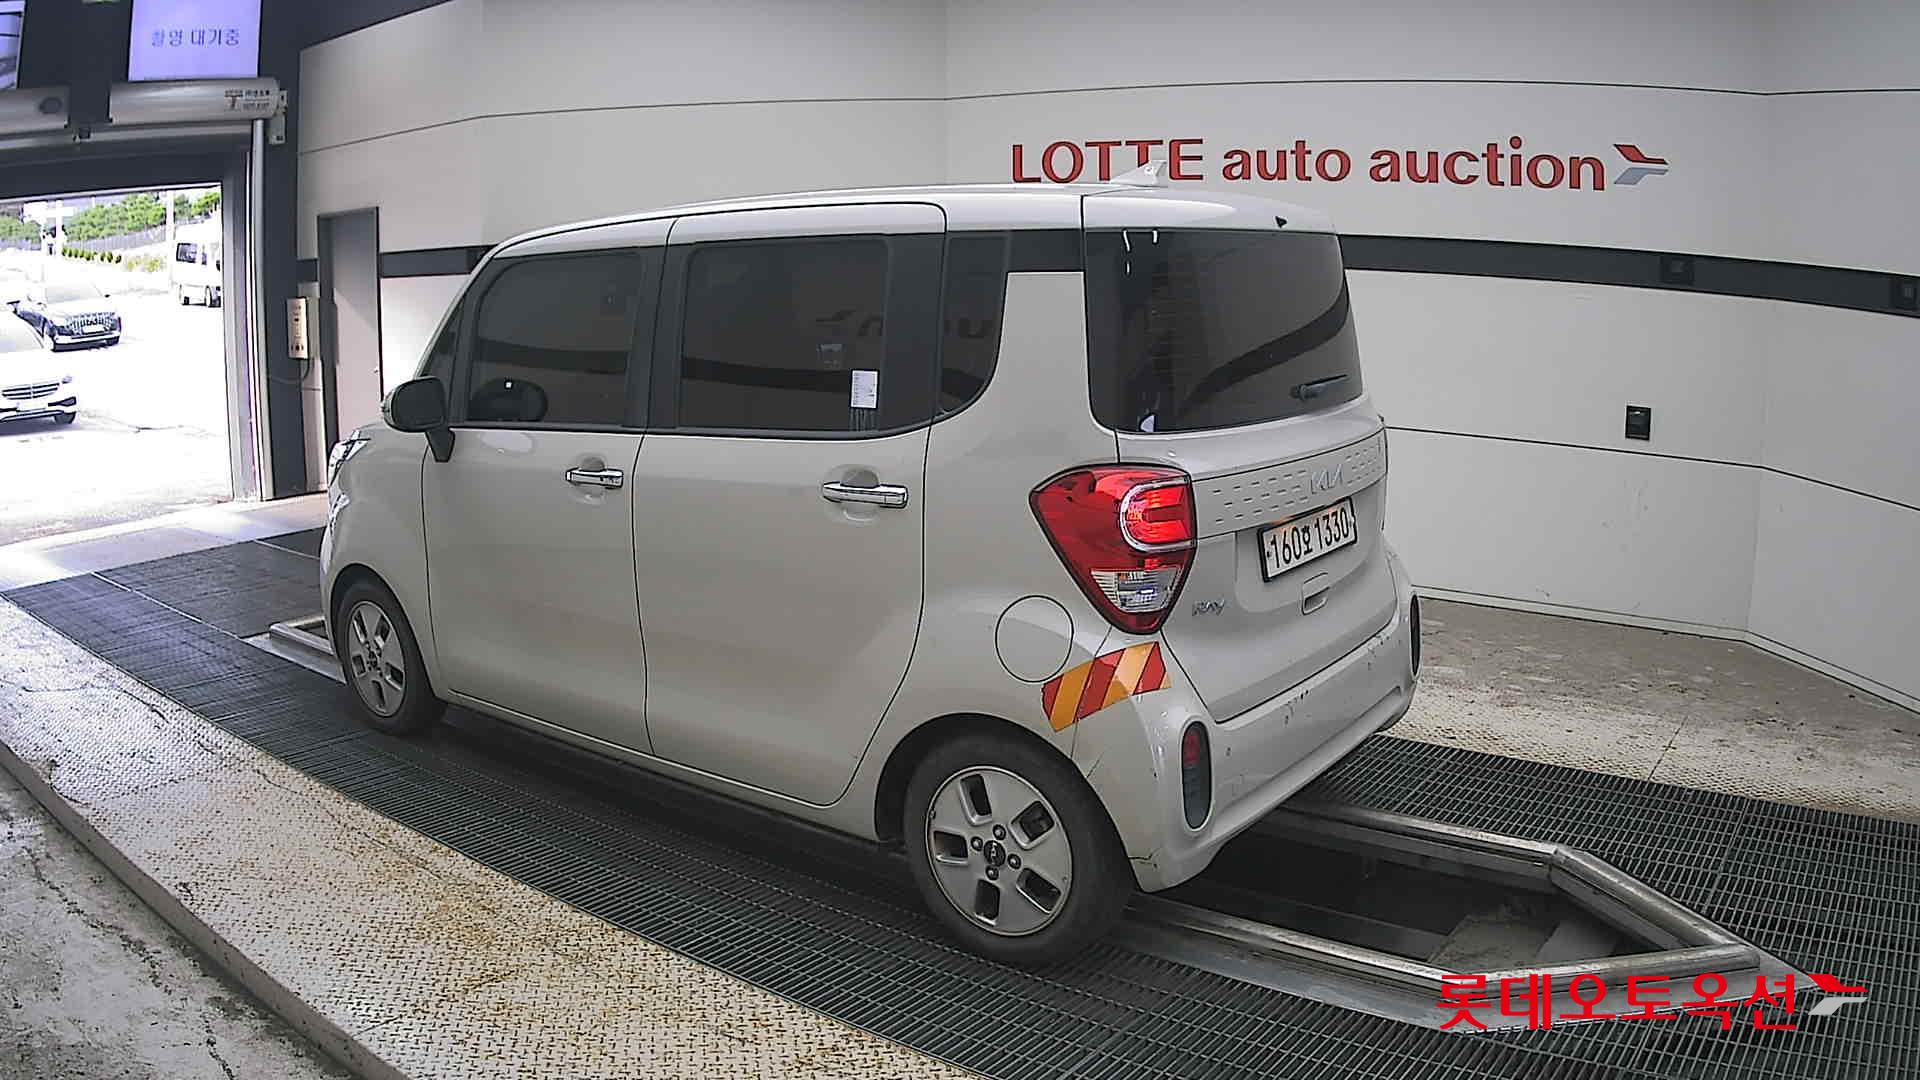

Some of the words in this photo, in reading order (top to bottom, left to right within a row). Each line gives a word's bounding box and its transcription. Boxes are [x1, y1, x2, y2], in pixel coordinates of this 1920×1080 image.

[191, 29, 240, 47] 대기중
[1012, 138, 1204, 184] LOTTE
[1221, 139, 1351, 183] auto
[1369, 135, 1606, 191] auction
[1314, 507, 1350, 550] 1330
